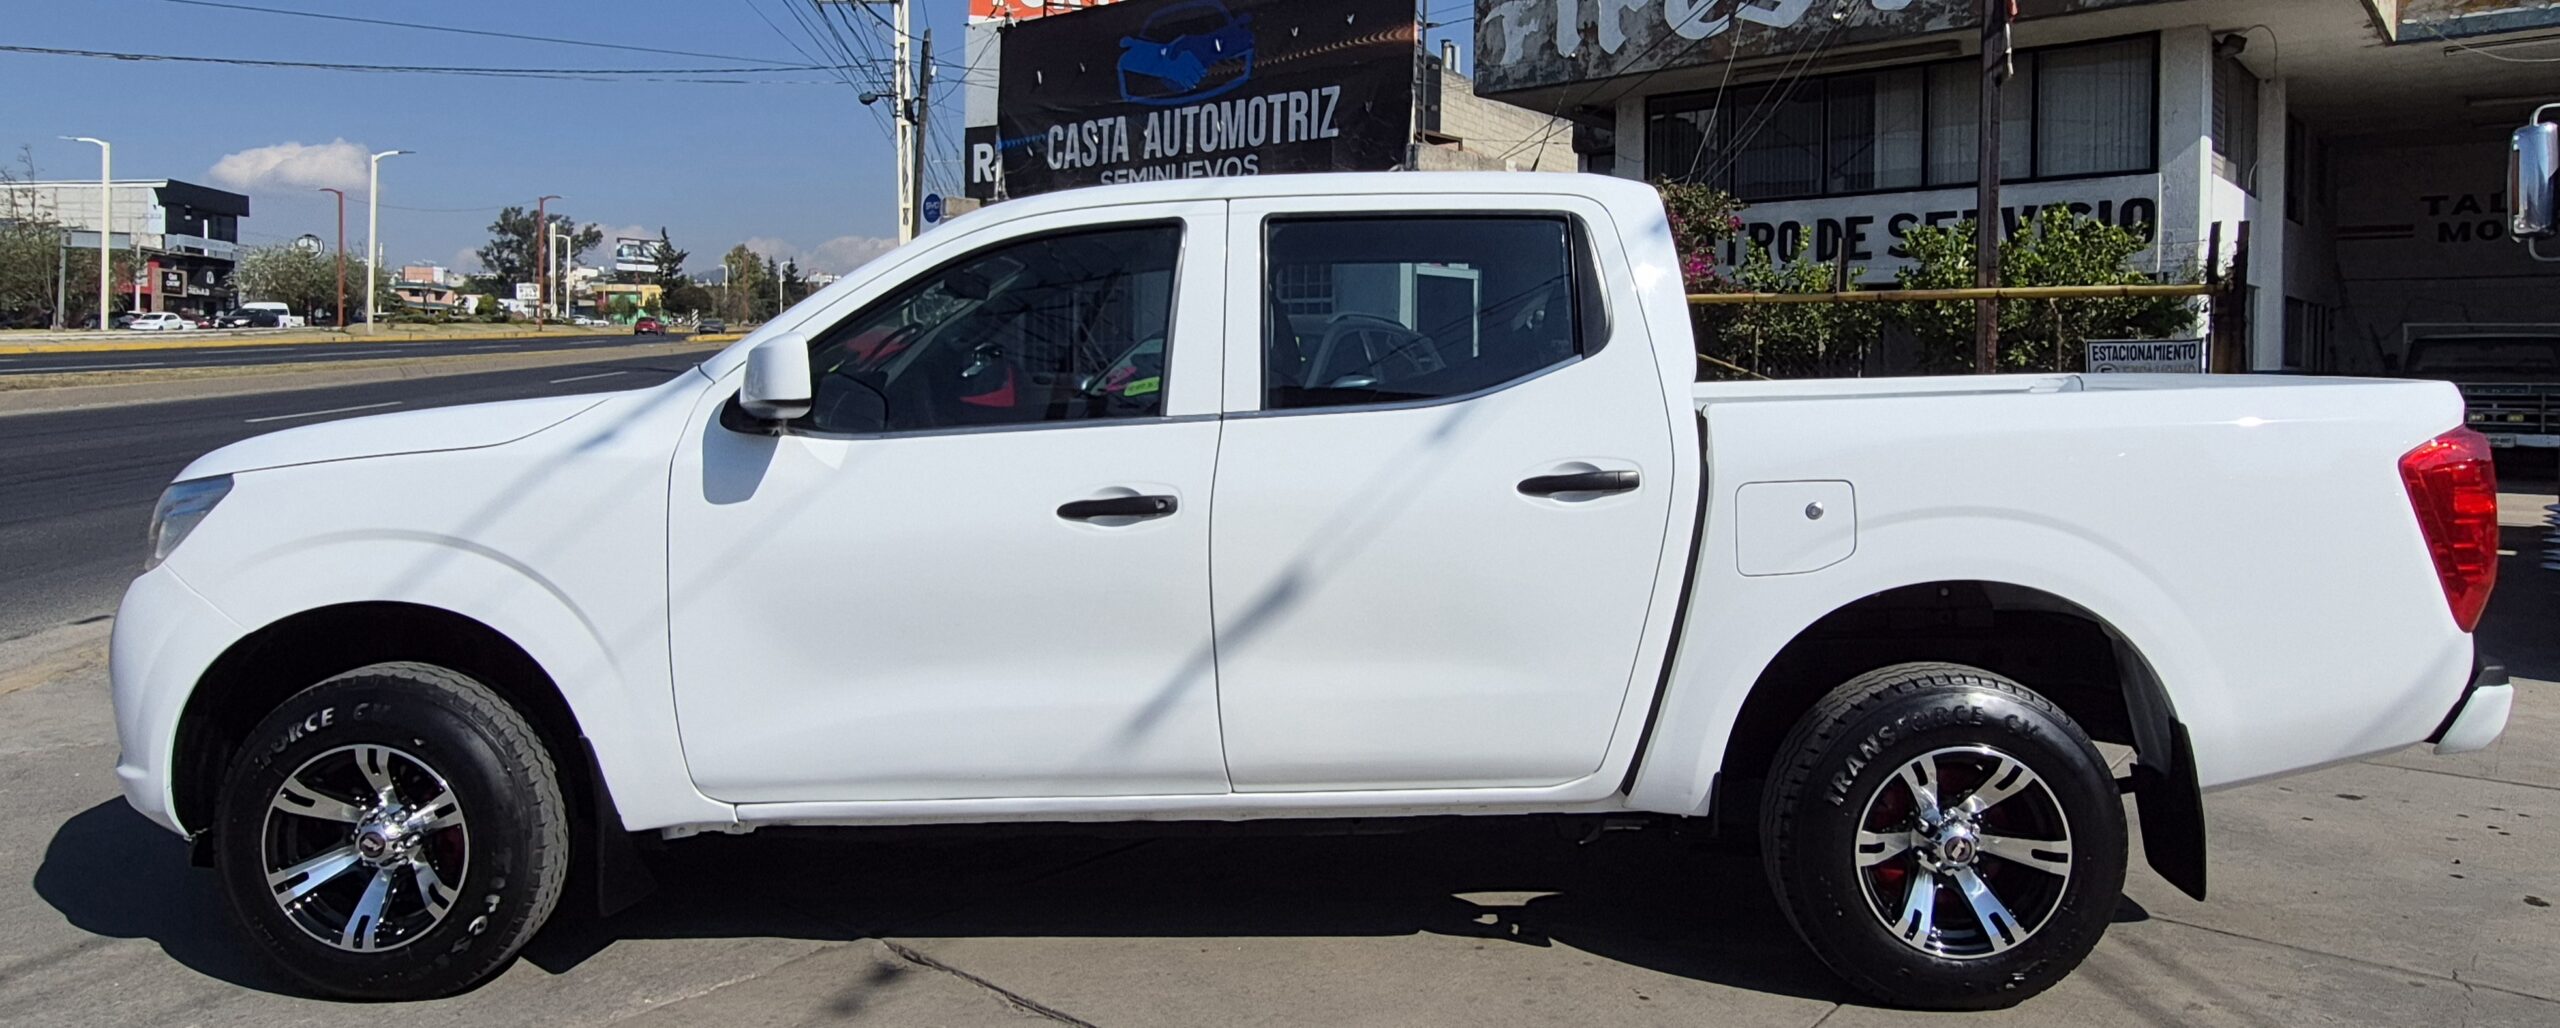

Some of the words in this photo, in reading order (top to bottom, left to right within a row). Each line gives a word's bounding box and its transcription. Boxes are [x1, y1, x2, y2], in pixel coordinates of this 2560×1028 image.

[1048, 116, 1129, 169] CASTA
[1143, 86, 1340, 159] AUTOMOTRIZ
[972, 143, 997, 183] R
[1101, 154, 1259, 185] SEMINUEVOS
[2420, 193, 2508, 216] TAL
[1816, 215, 1873, 262] DE
[2437, 220, 2504, 243] MO
[2092, 344, 2197, 361] ESTACIONAMIENTO
